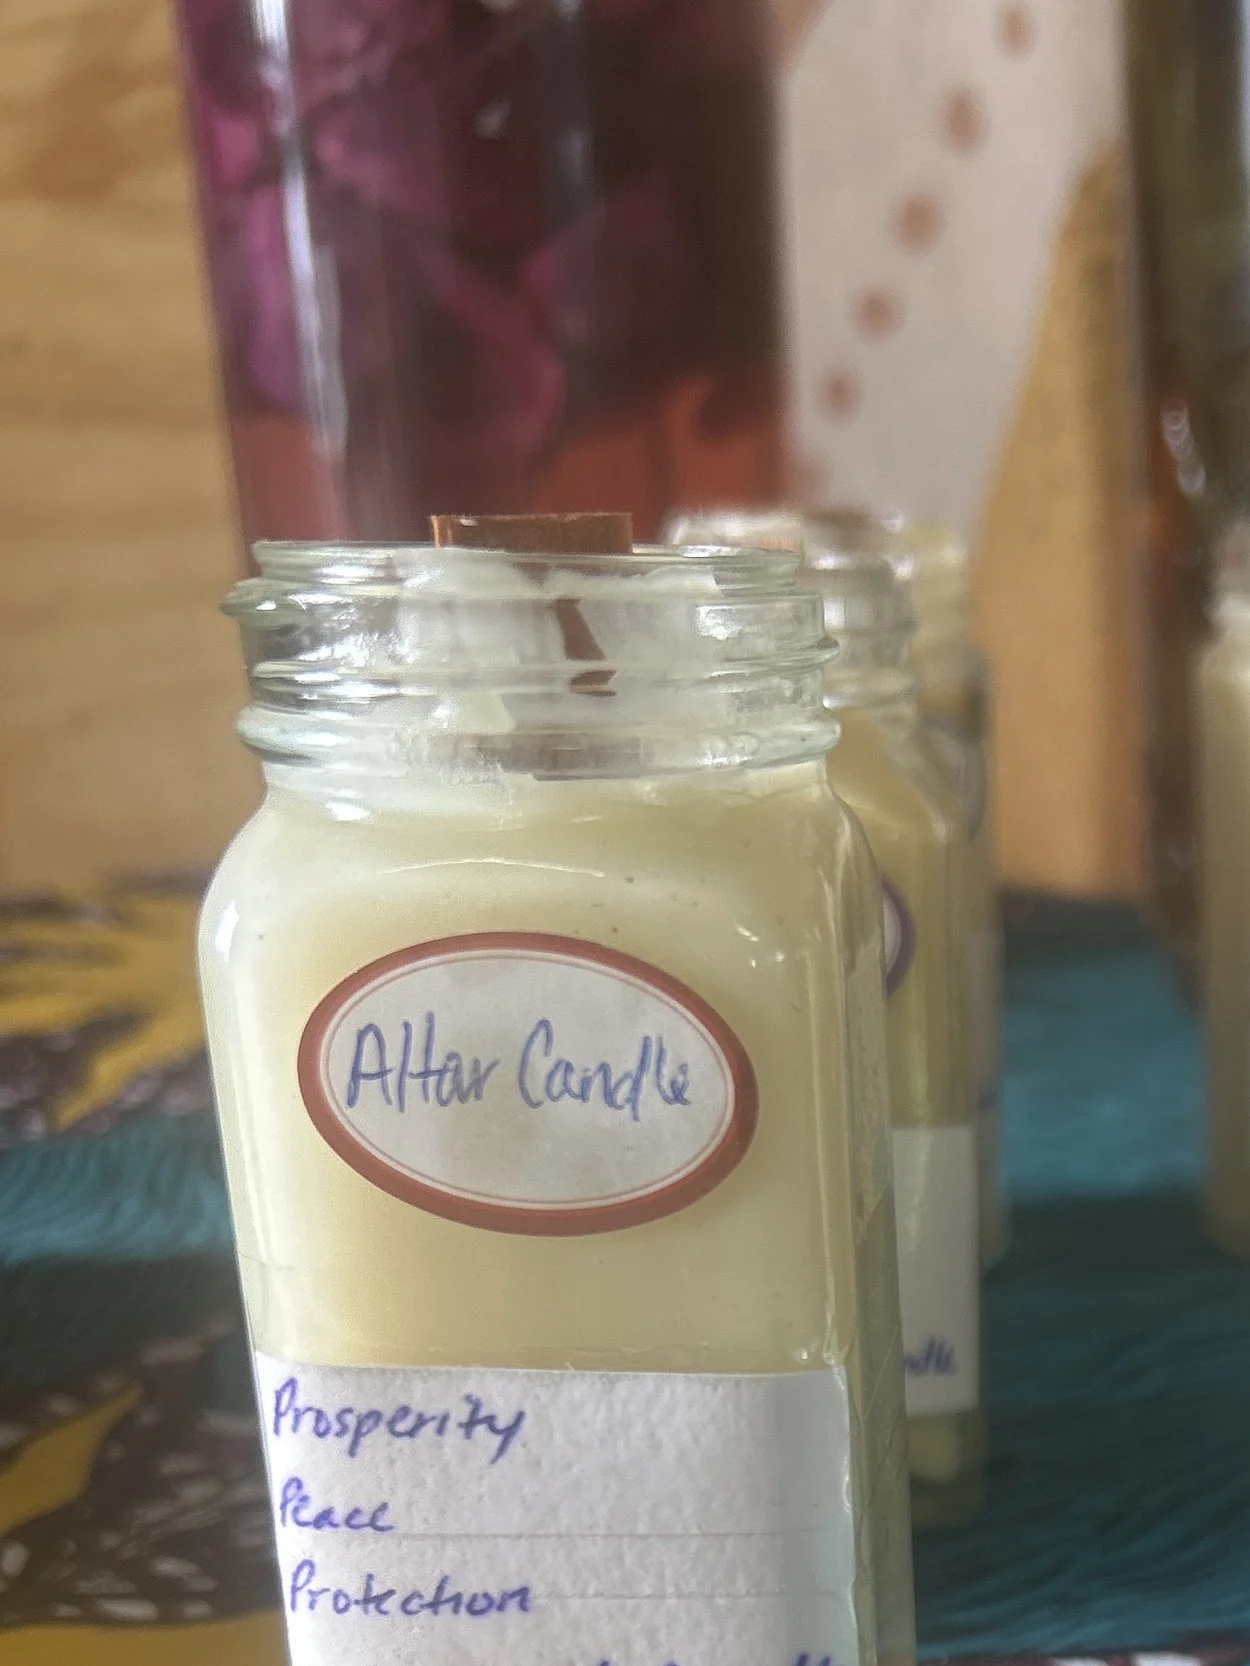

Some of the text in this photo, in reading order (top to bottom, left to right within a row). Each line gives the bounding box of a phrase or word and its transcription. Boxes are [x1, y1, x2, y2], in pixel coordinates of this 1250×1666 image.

[346, 1012, 691, 1121] Altar Candle
[272, 1377, 526, 1463] Prosperity
[280, 1477, 394, 1533] Peace
[291, 1558, 531, 1617] Protection
